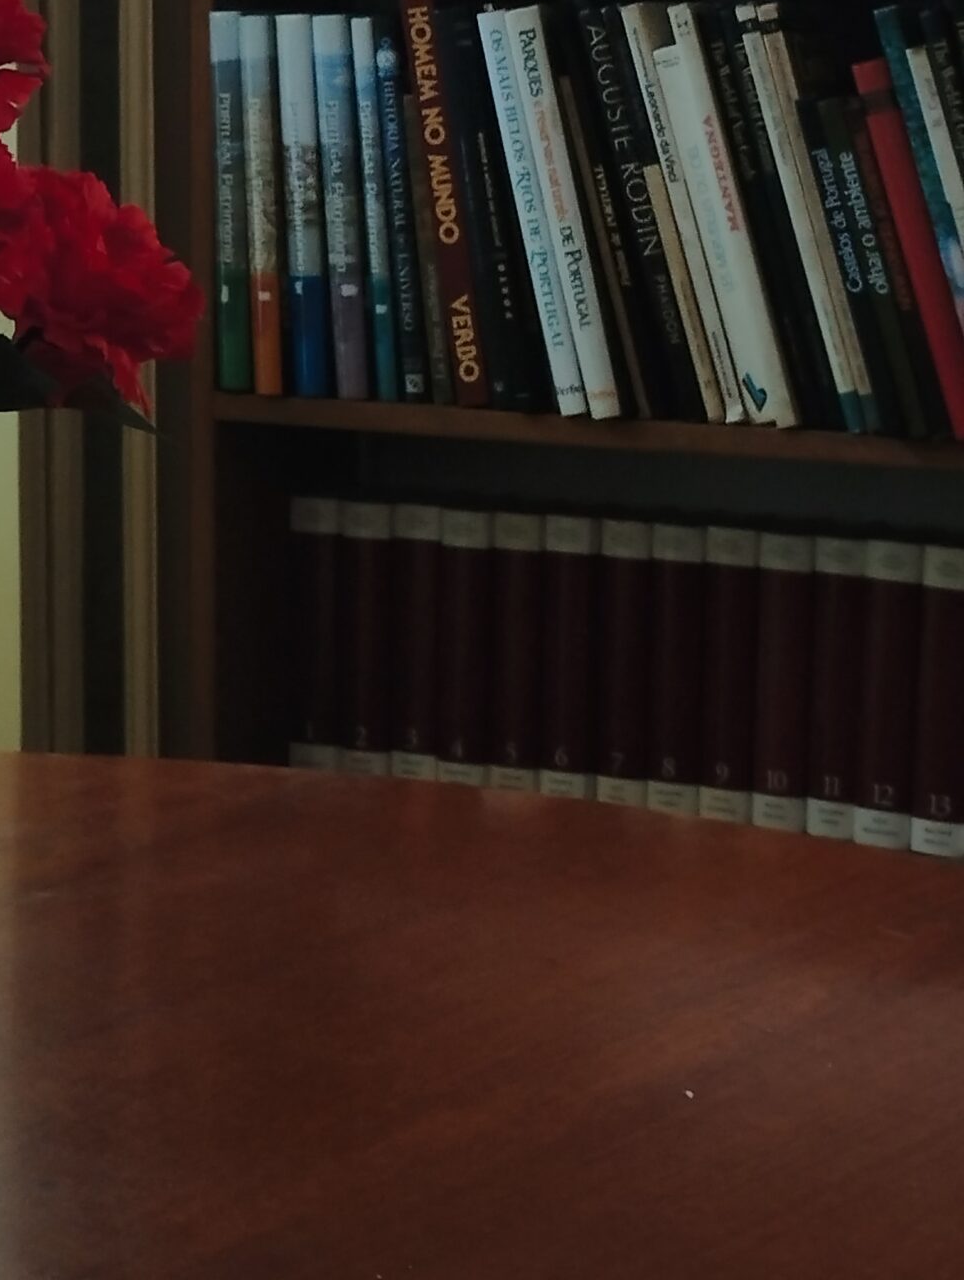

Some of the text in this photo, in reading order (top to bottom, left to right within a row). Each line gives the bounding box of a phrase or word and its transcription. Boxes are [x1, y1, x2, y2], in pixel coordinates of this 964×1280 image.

[405, 5, 441, 102] HOMEM
[492, 54, 516, 102] MAIS
[515, 26, 551, 98] PARQUES
[419, 106, 447, 147] NO
[502, 104, 528, 163] BELOS
[643, 82, 681, 184] Leonardo da Vinci
[511, 165, 541, 215] RIOS
[584, 22, 683, 346] AUGUSTE RODIN PHAIDON
[699, 114, 741, 233] MANTEGNA
[836, 148, 873, 232] ambiente
[426, 151, 461, 247] MUNDO
[811, 145, 865, 294] Castelos de Portugal
[384, 157, 418, 332] NATURAL UNIVERSO
[526, 217, 544, 243] DE
[558, 224, 576, 248] DE
[859, 232, 877, 248] o
[562, 247, 599, 332] PORTUGAL
[862, 247, 891, 297] olhar
[529, 245, 569, 351] PORTUGAL
[447, 293, 481, 385] VERBO
[555, 747, 569, 767] 6
[661, 756, 676, 778] 8
[715, 761, 729, 784] 9
[767, 769, 788, 791] 10
[823, 775, 841, 796] 11
[872, 784, 895, 806] 12
[930, 793, 951, 817] 13
